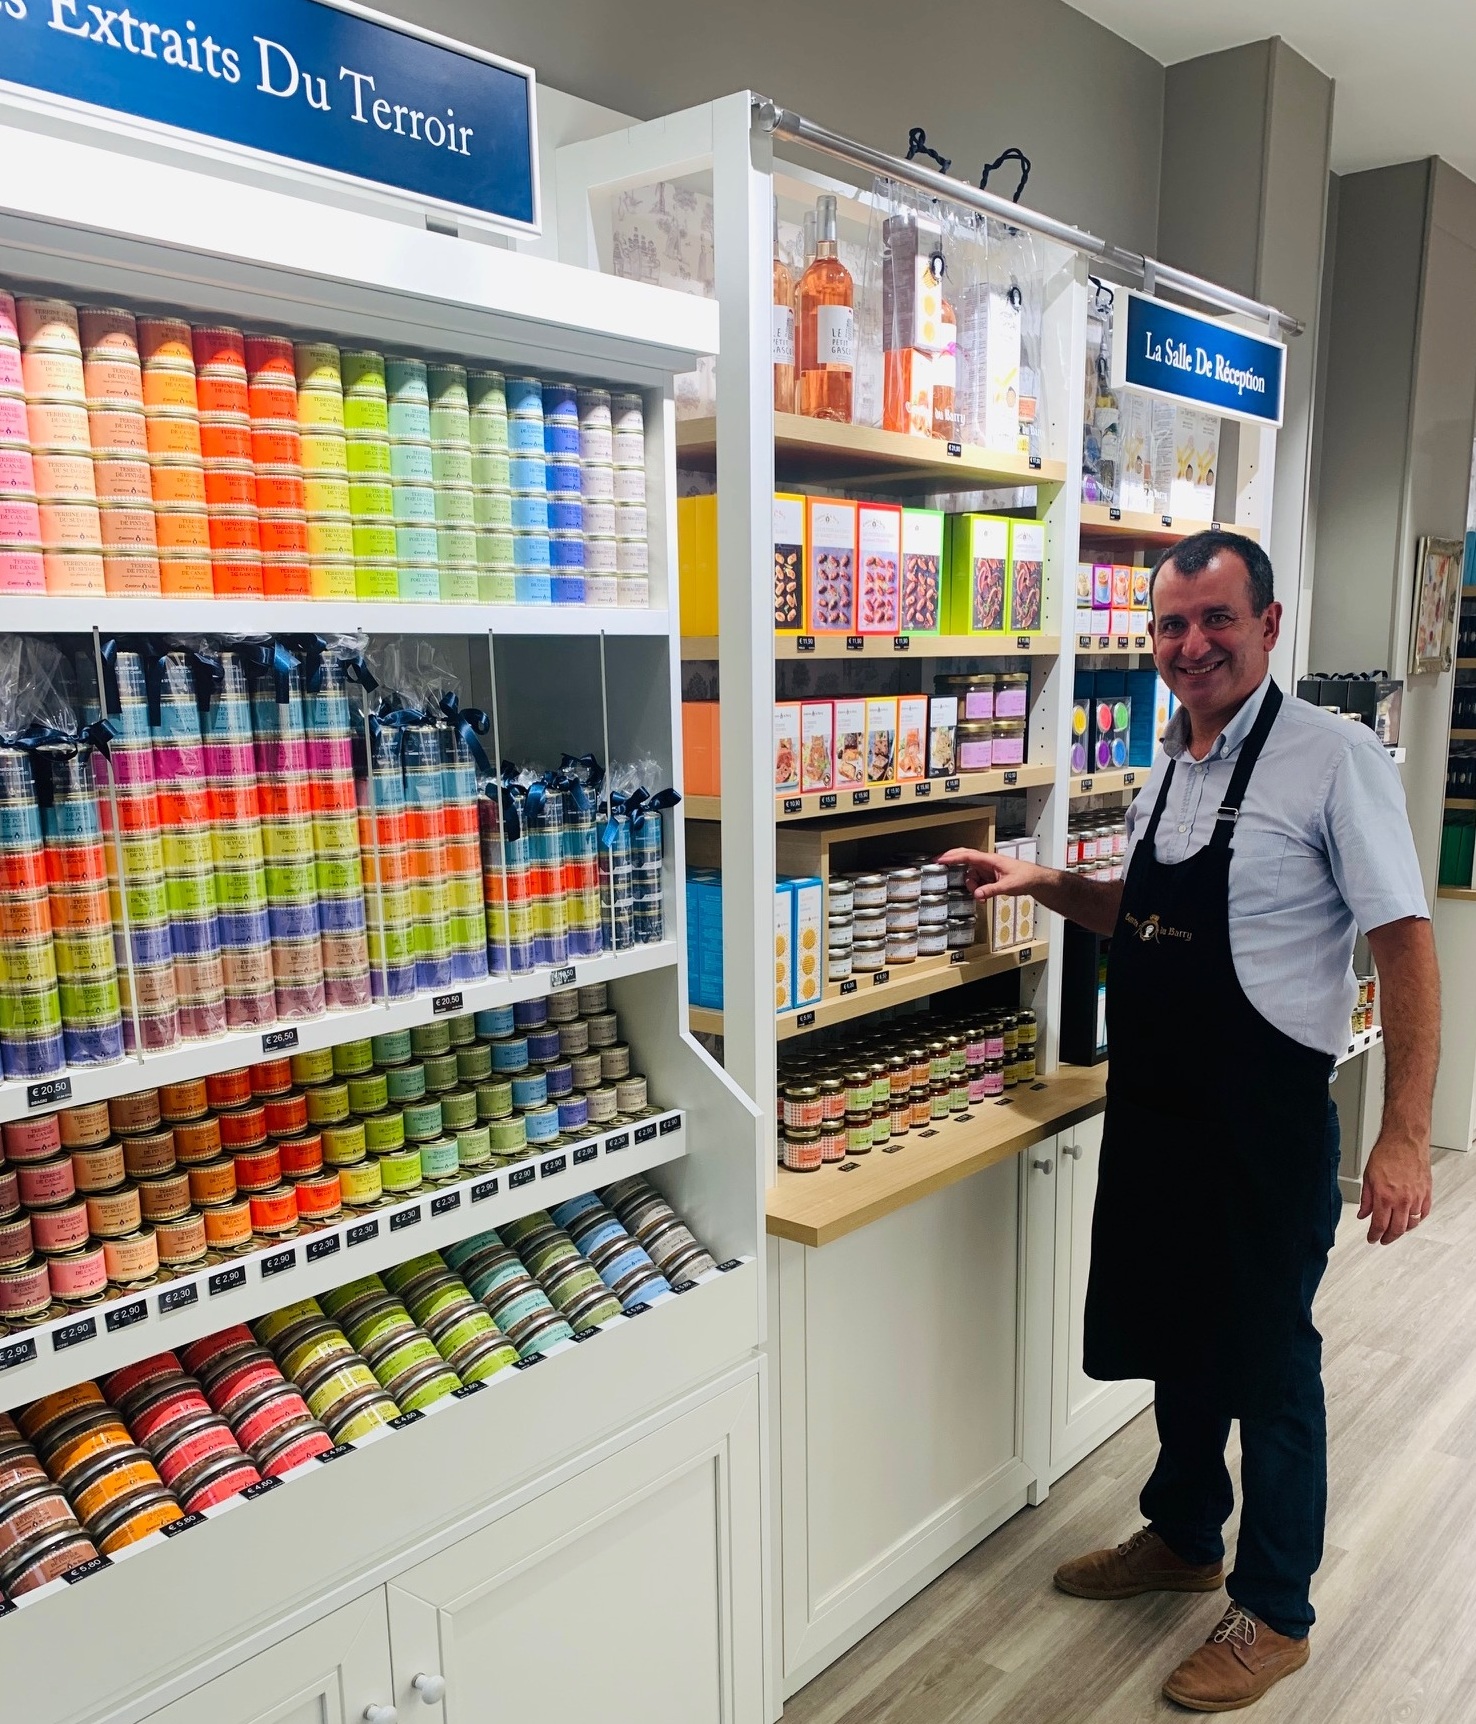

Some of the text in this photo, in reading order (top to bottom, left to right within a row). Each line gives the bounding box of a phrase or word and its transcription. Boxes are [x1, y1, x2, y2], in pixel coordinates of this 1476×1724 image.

[48, 0, 241, 83] Extraits
[253, 36, 331, 111] Du
[339, 66, 474, 156] Terroir
[832, 328, 841, 337] LE
[1145, 331, 1266, 396] La Salle De Réception
[1168, 927, 1192, 941] Barry
[436, 995, 460, 1006] € 20,50
[273, 1032, 293, 1043] 26,50
[32, 1082, 66, 1096] € 20,50
[518, 1170, 531, 1179] 2,90
[401, 1210, 416, 1220] 2,30
[358, 1225, 374, 1236] 2,30
[318, 1239, 334, 1250] 2,30
[274, 1254, 290, 1266] 2,90
[222, 1271, 239, 1282] 2,90
[172, 1289, 190, 1301] 2,30
[113, 1306, 140, 1320] € 2,90
[61, 1324, 89, 1339] € 2,90
[7, 1345, 28, 1359] 2,90
[177, 1515, 196, 1527] 5,80
[80, 1559, 101, 1572] 5,80
